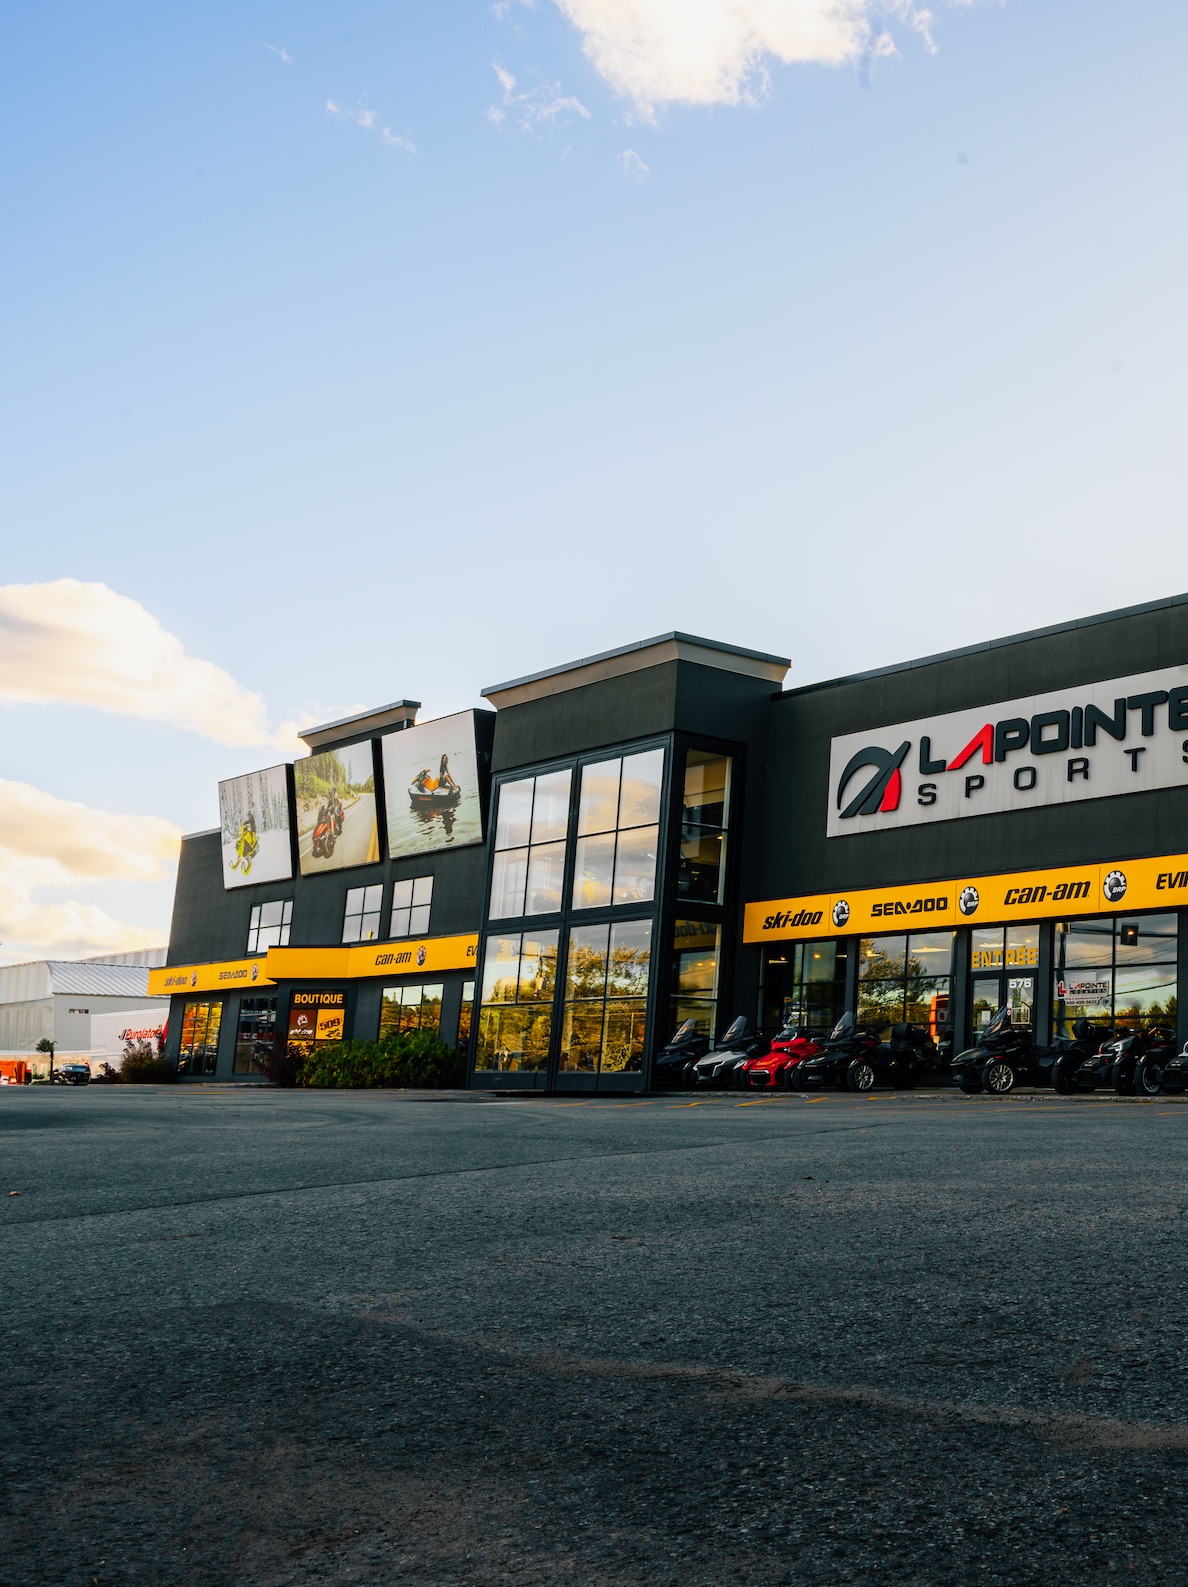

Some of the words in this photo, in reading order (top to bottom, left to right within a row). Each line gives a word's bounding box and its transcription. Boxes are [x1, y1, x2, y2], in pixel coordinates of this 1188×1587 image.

[763, 909, 823, 930] ski-doo
[1003, 880, 1090, 906] can-am
[374, 951, 412, 966] can-am
[971, 945, 1037, 968] ENTRÉE
[164, 974, 188, 987] ski-doo
[1009, 978, 1032, 988] 576
[294, 993, 343, 1004] BOUTIQUE
